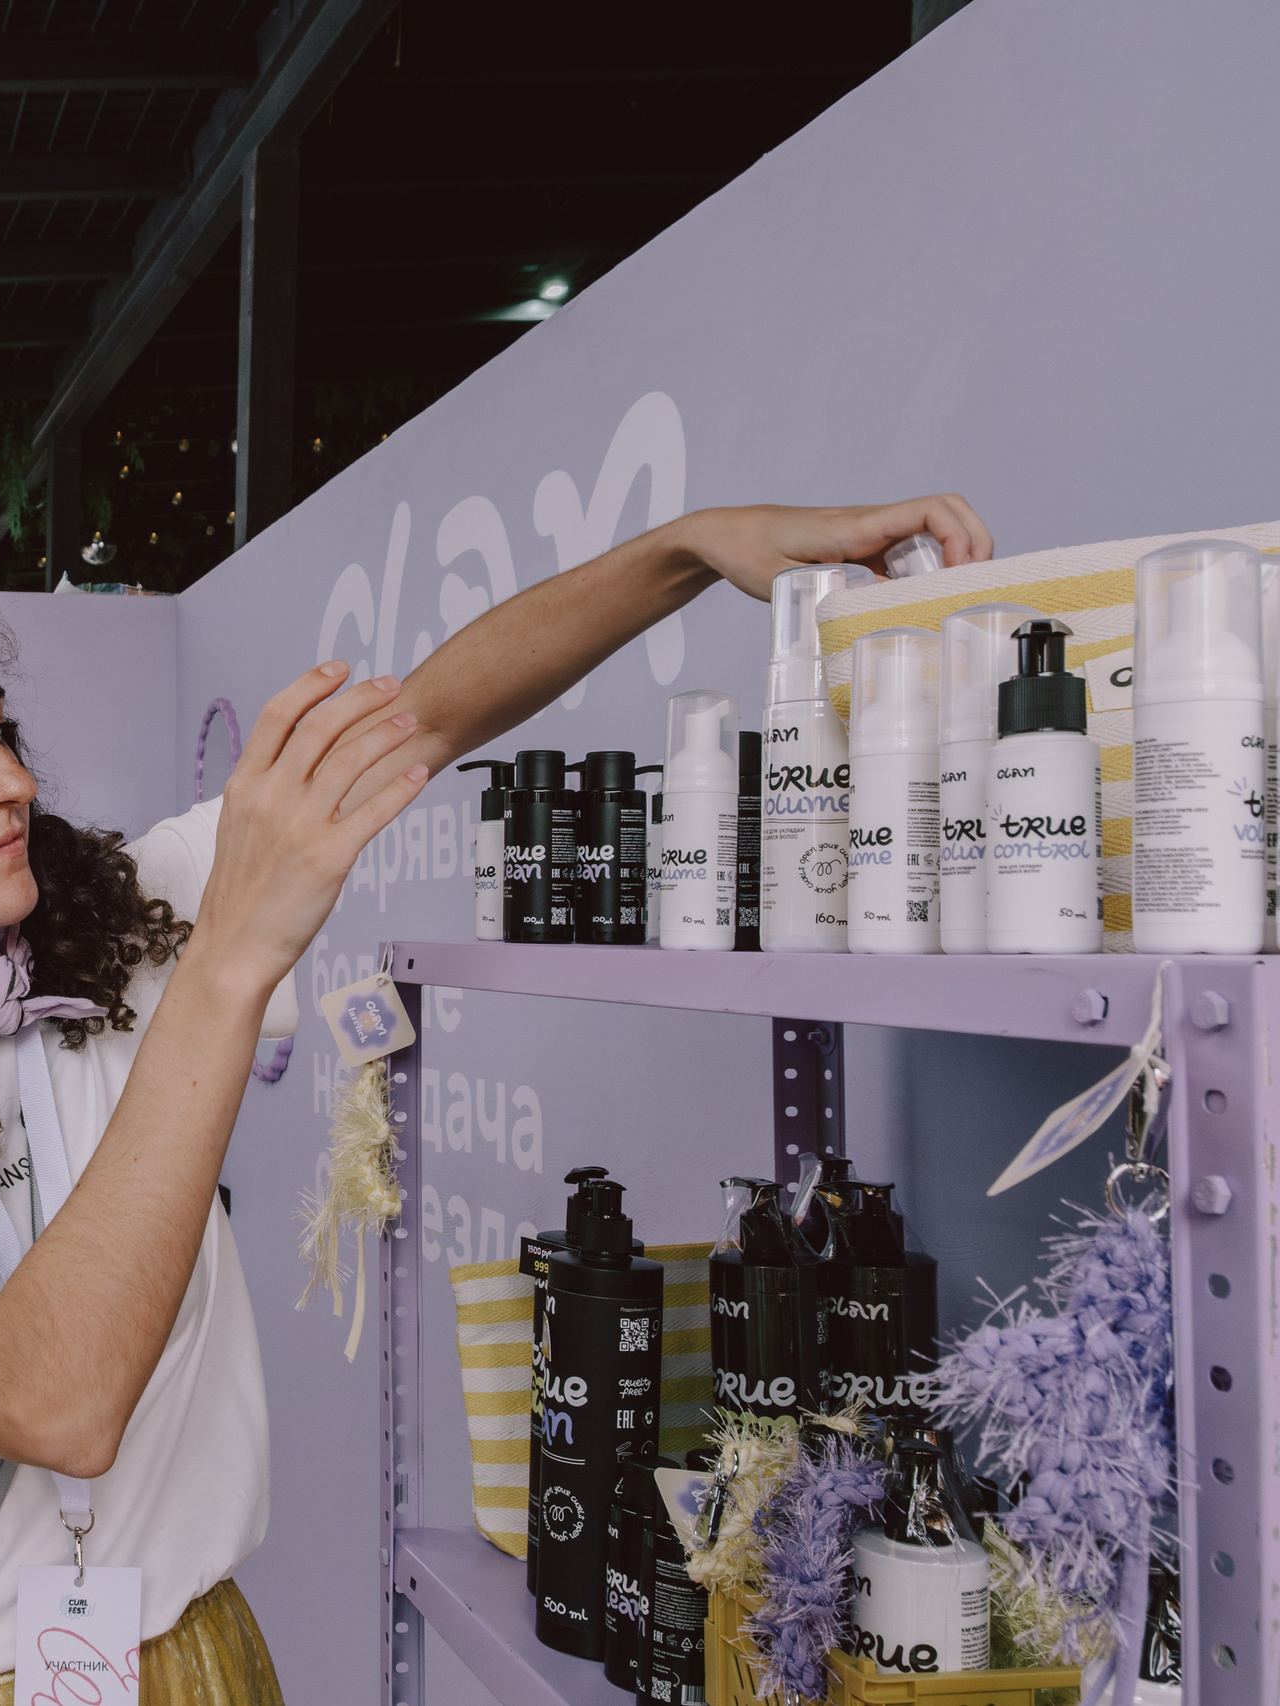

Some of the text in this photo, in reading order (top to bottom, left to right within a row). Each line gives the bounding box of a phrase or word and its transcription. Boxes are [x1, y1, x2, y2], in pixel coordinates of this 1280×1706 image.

[997, 767, 1035, 780] clan
[764, 793, 849, 816] olume
[1000, 814, 1087, 839] true
[849, 827, 894, 849] rue
[503, 844, 546, 863] rue
[576, 844, 615, 863] rue
[993, 840, 1091, 860] control
[682, 915, 693, 924] 50
[815, 912, 836, 924] 160
[863, 911, 875, 920] 50
[1058, 908, 1073, 918] 50
[366, 1000, 388, 1037] clan
[534, 1260, 549, 1274] 999
[711, 1293, 749, 1320] lan
[828, 1296, 889, 1321] clan
[618, 1377, 652, 1392] cruelty
[619, 1386, 643, 1400] free
[714, 1367, 797, 1407] rue
[616, 1409, 635, 1429] EAC
[543, 1596, 589, 1621] 500 ml
[853, 1624, 940, 1673] rue
[44, 1660, 109, 1671] УЧАСТНИК
